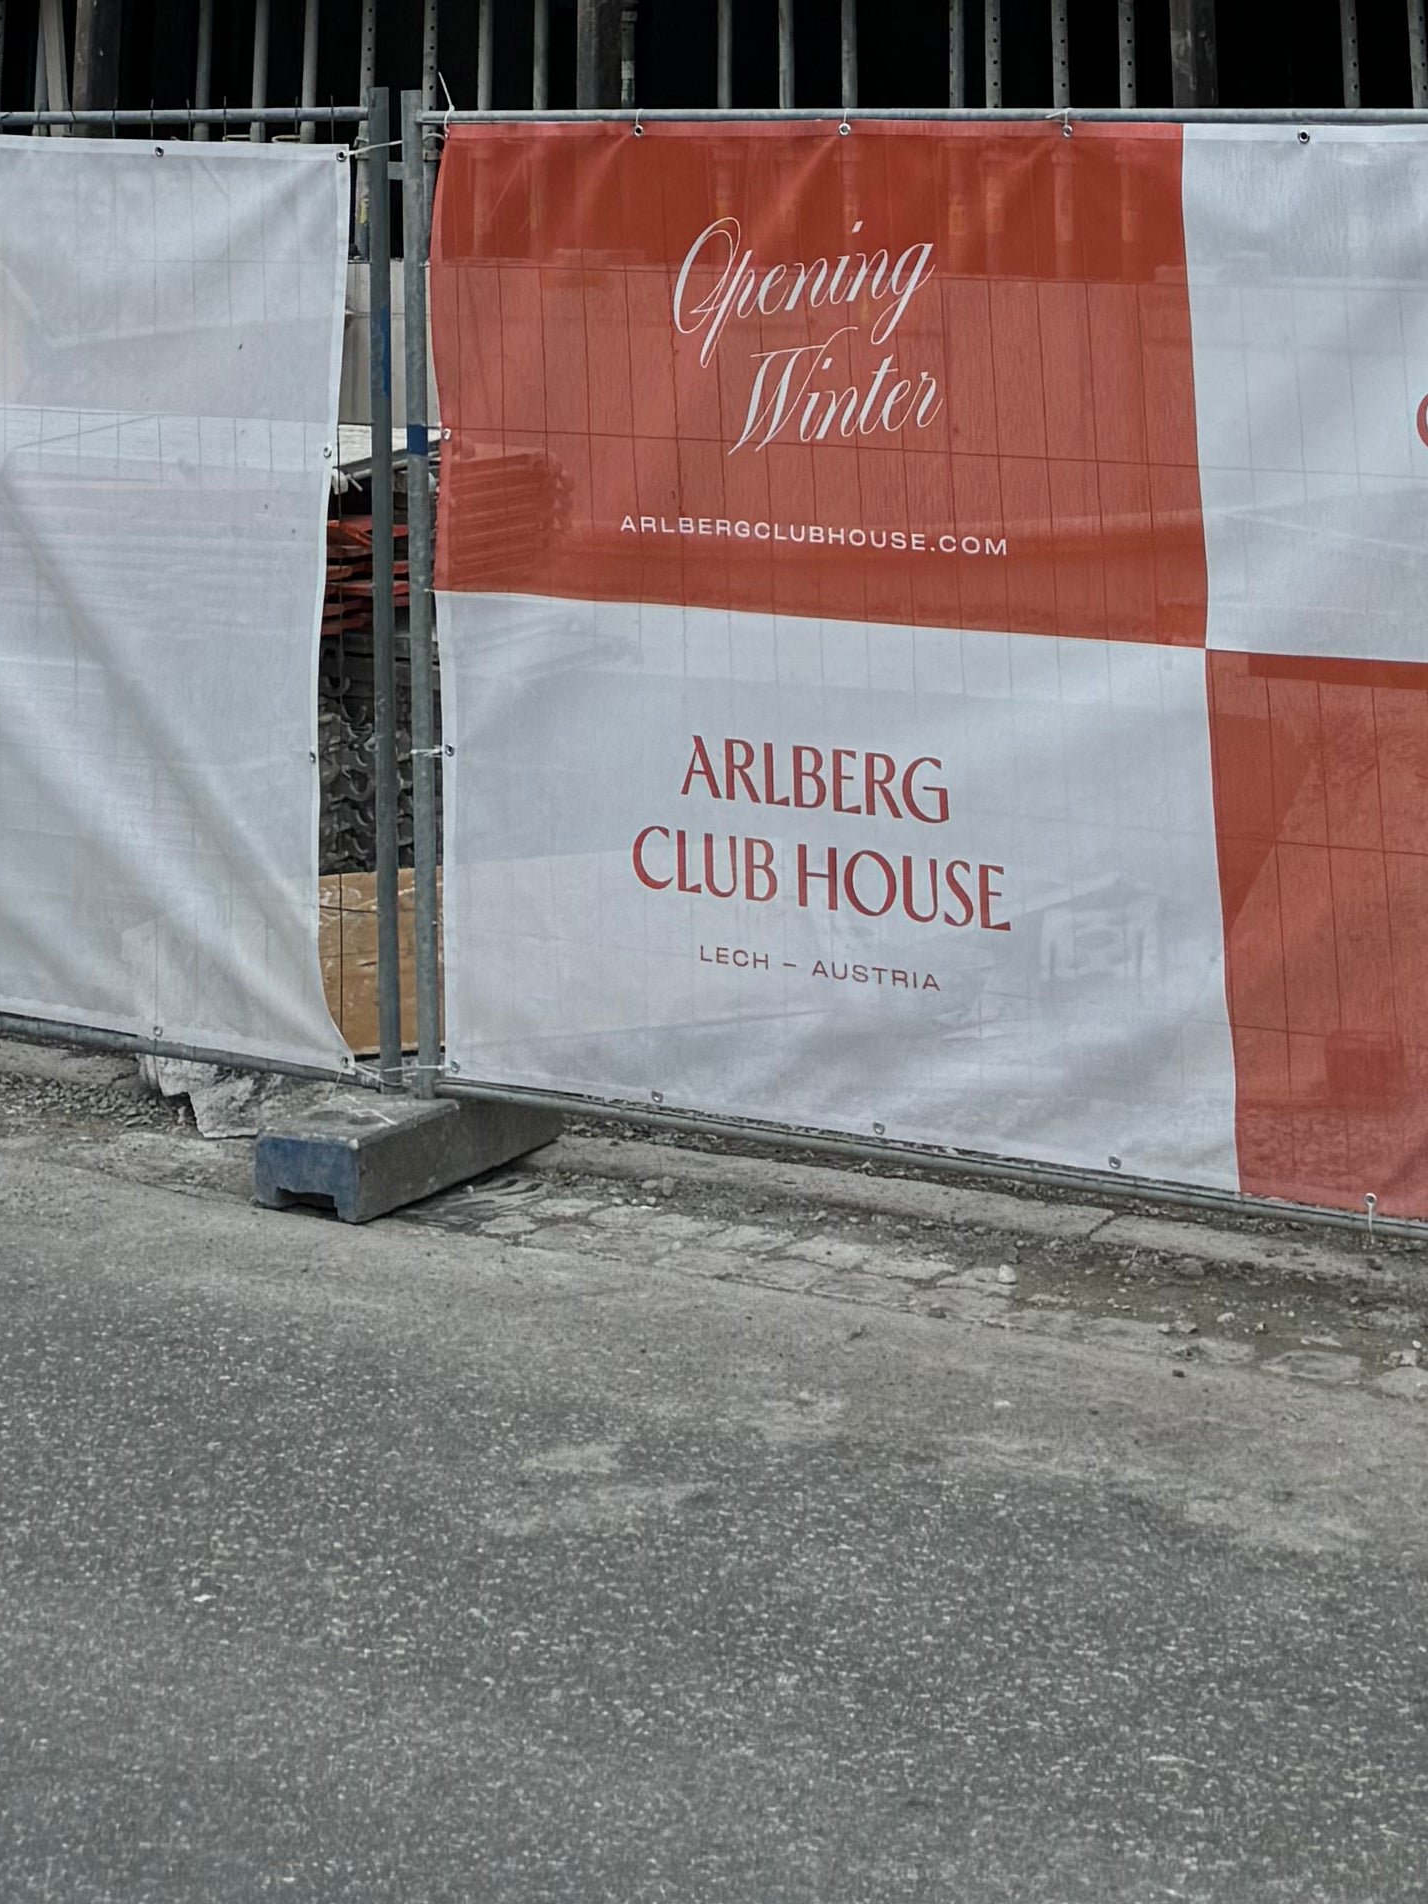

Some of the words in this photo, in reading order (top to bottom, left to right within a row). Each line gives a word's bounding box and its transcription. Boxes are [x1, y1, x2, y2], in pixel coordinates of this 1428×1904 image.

[673, 217, 935, 368] Opening
[728, 326, 943, 455] Winter
[620, 514, 1008, 555] ARLBERGCLUBHOUSE.COM
[681, 735, 950, 823] ARLBERG
[632, 825, 777, 902] CLUB
[797, 844, 1011, 931] HOUSE
[699, 945, 770, 970] LECH
[811, 959, 940, 992] AUSTRIA
